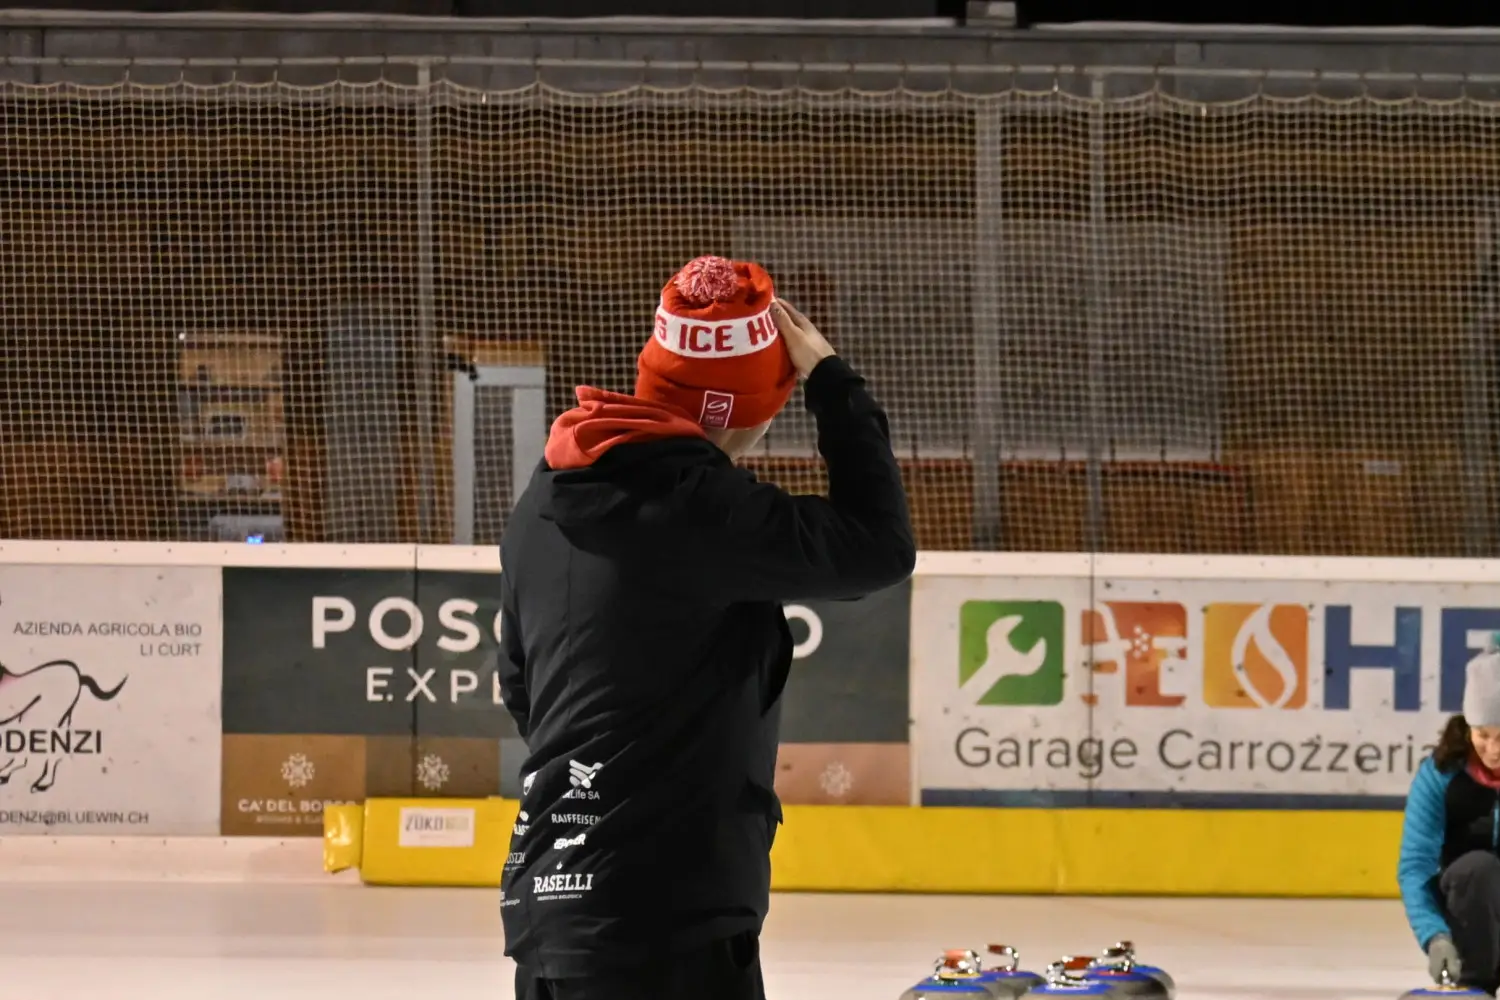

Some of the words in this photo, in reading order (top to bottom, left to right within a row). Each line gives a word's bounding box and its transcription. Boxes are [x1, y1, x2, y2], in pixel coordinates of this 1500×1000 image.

[679, 324, 734, 353] ICE
[13, 622, 83, 636] AZIENDA
[87, 623, 170, 637] AGRICOLA
[174, 623, 202, 637] BIO
[140, 643, 155, 656] LI
[159, 644, 202, 657] CURT
[0, 730, 102, 754] DENZI
[955, 727, 1138, 779] Garage
[1158, 729, 1434, 774] Carrozzeria
[266, 800, 296, 812] DEL
[533, 873, 593, 893] RASELLI
